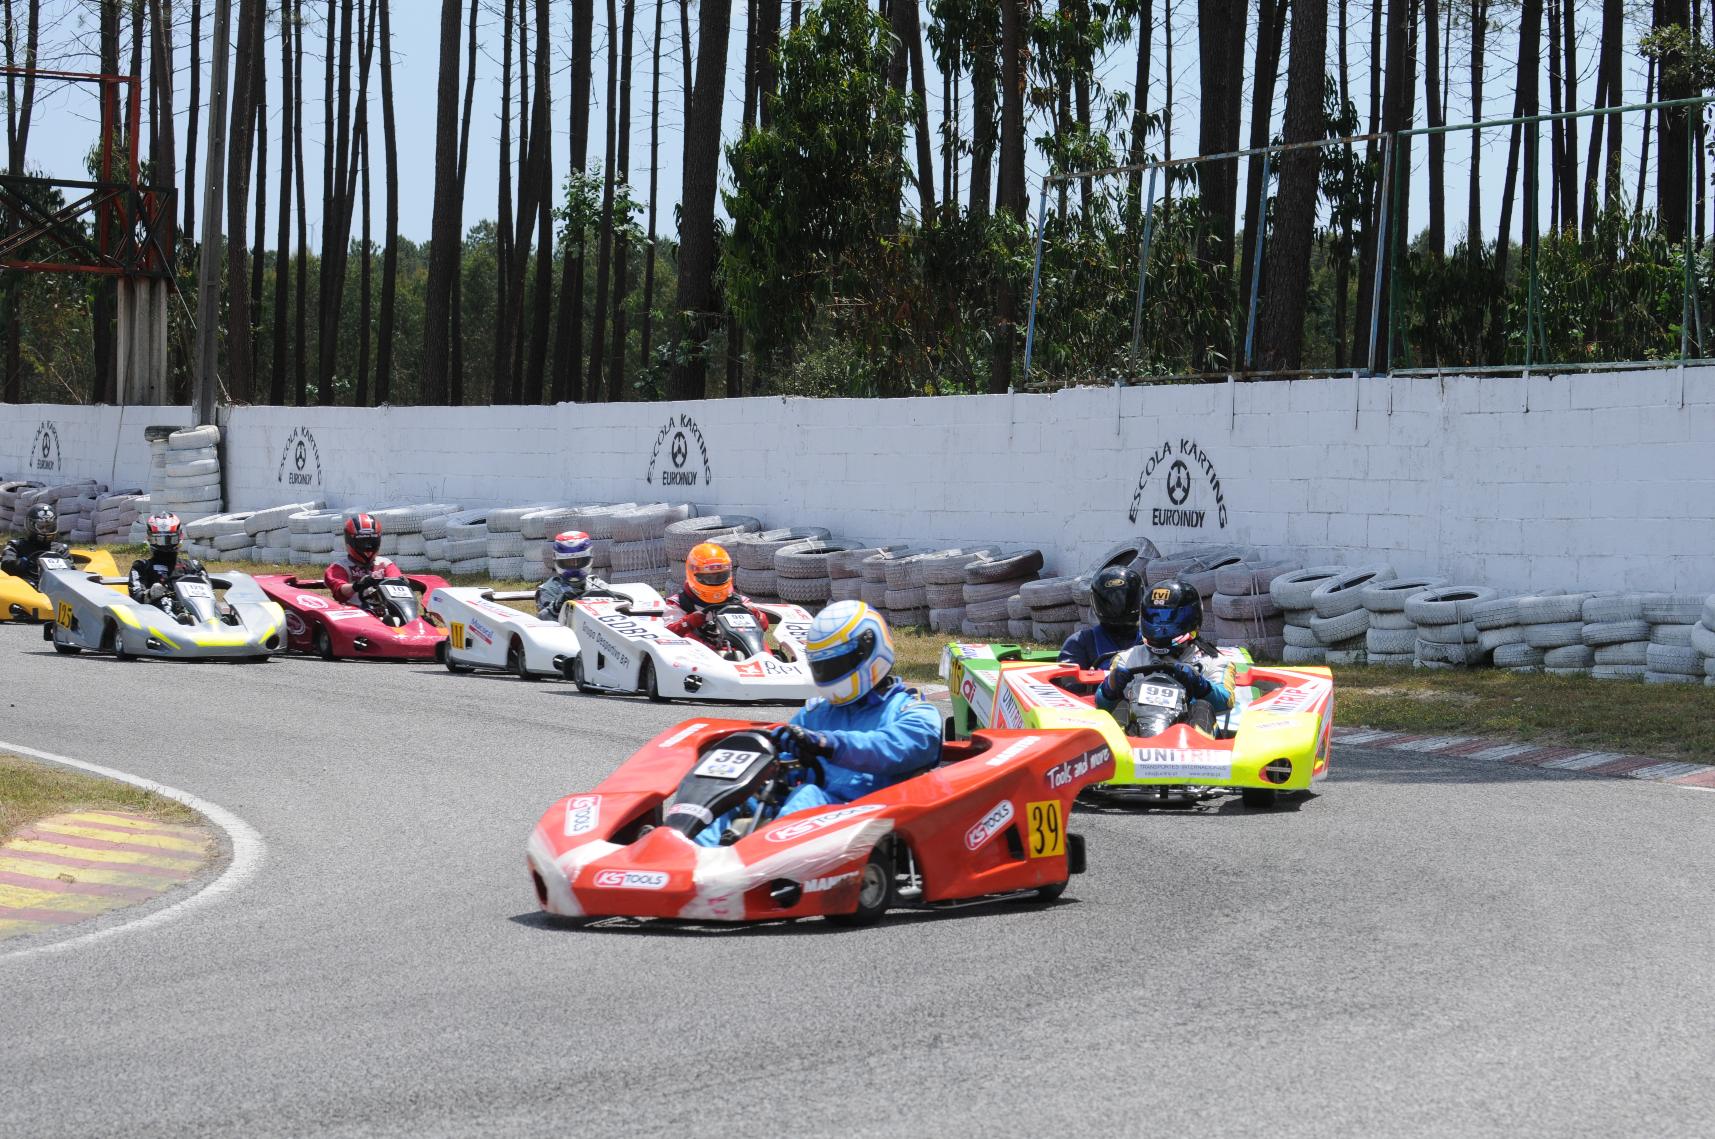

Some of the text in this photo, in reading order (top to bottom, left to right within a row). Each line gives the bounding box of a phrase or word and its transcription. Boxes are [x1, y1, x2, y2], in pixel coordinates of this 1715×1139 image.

[647, 412, 712, 486] ESCOLA KARTING
[662, 470, 698, 486] EUROINDY
[1128, 438, 1228, 529] ESCOLA KARTING
[1152, 507, 1206, 528] EUROINDY
[1152, 589, 1170, 601] tvi
[57, 601, 73, 629] 125
[1145, 685, 1174, 698] 99
[1264, 689, 1310, 714] NITRIP
[714, 751, 753, 765] 39
[1046, 747, 1110, 789] Tools and more
[775, 804, 875, 840] KS TOOLS
[968, 803, 1011, 847] KS TOOLS
[1032, 803, 1059, 855] 39
[598, 871, 664, 886] KS TOOLS
